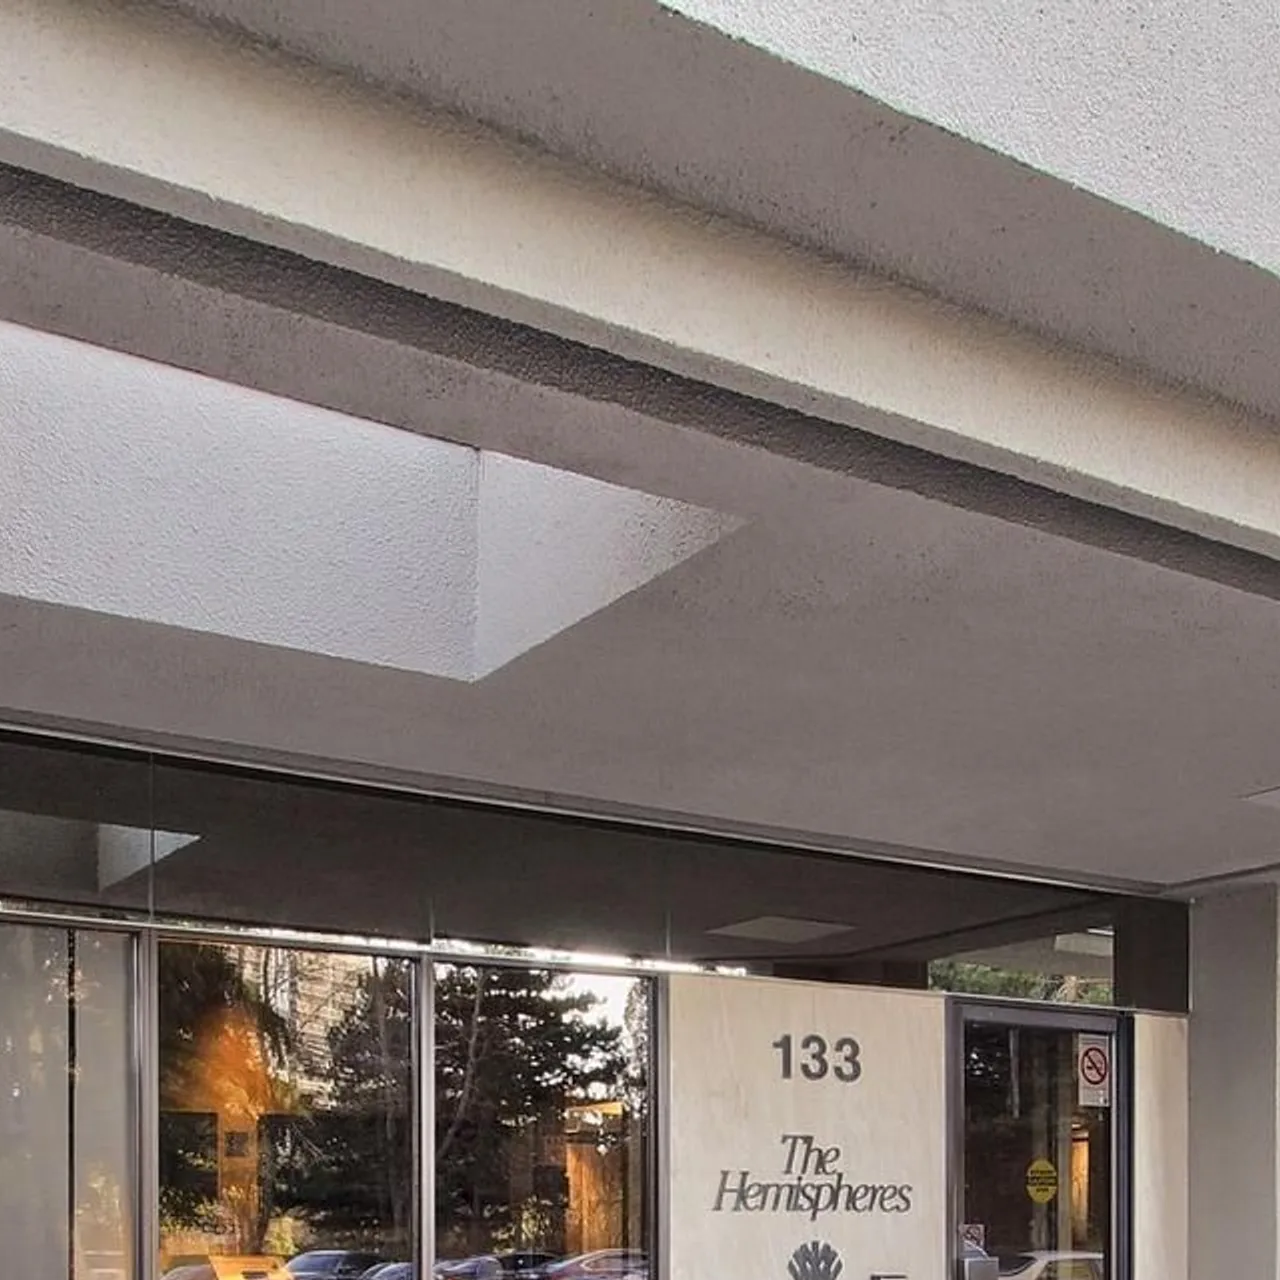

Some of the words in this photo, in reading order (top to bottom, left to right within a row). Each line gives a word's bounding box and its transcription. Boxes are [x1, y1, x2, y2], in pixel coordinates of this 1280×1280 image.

[771, 1034, 862, 1083] 133
[781, 1134, 841, 1176] The
[712, 1169, 914, 1222] Hemispheres
